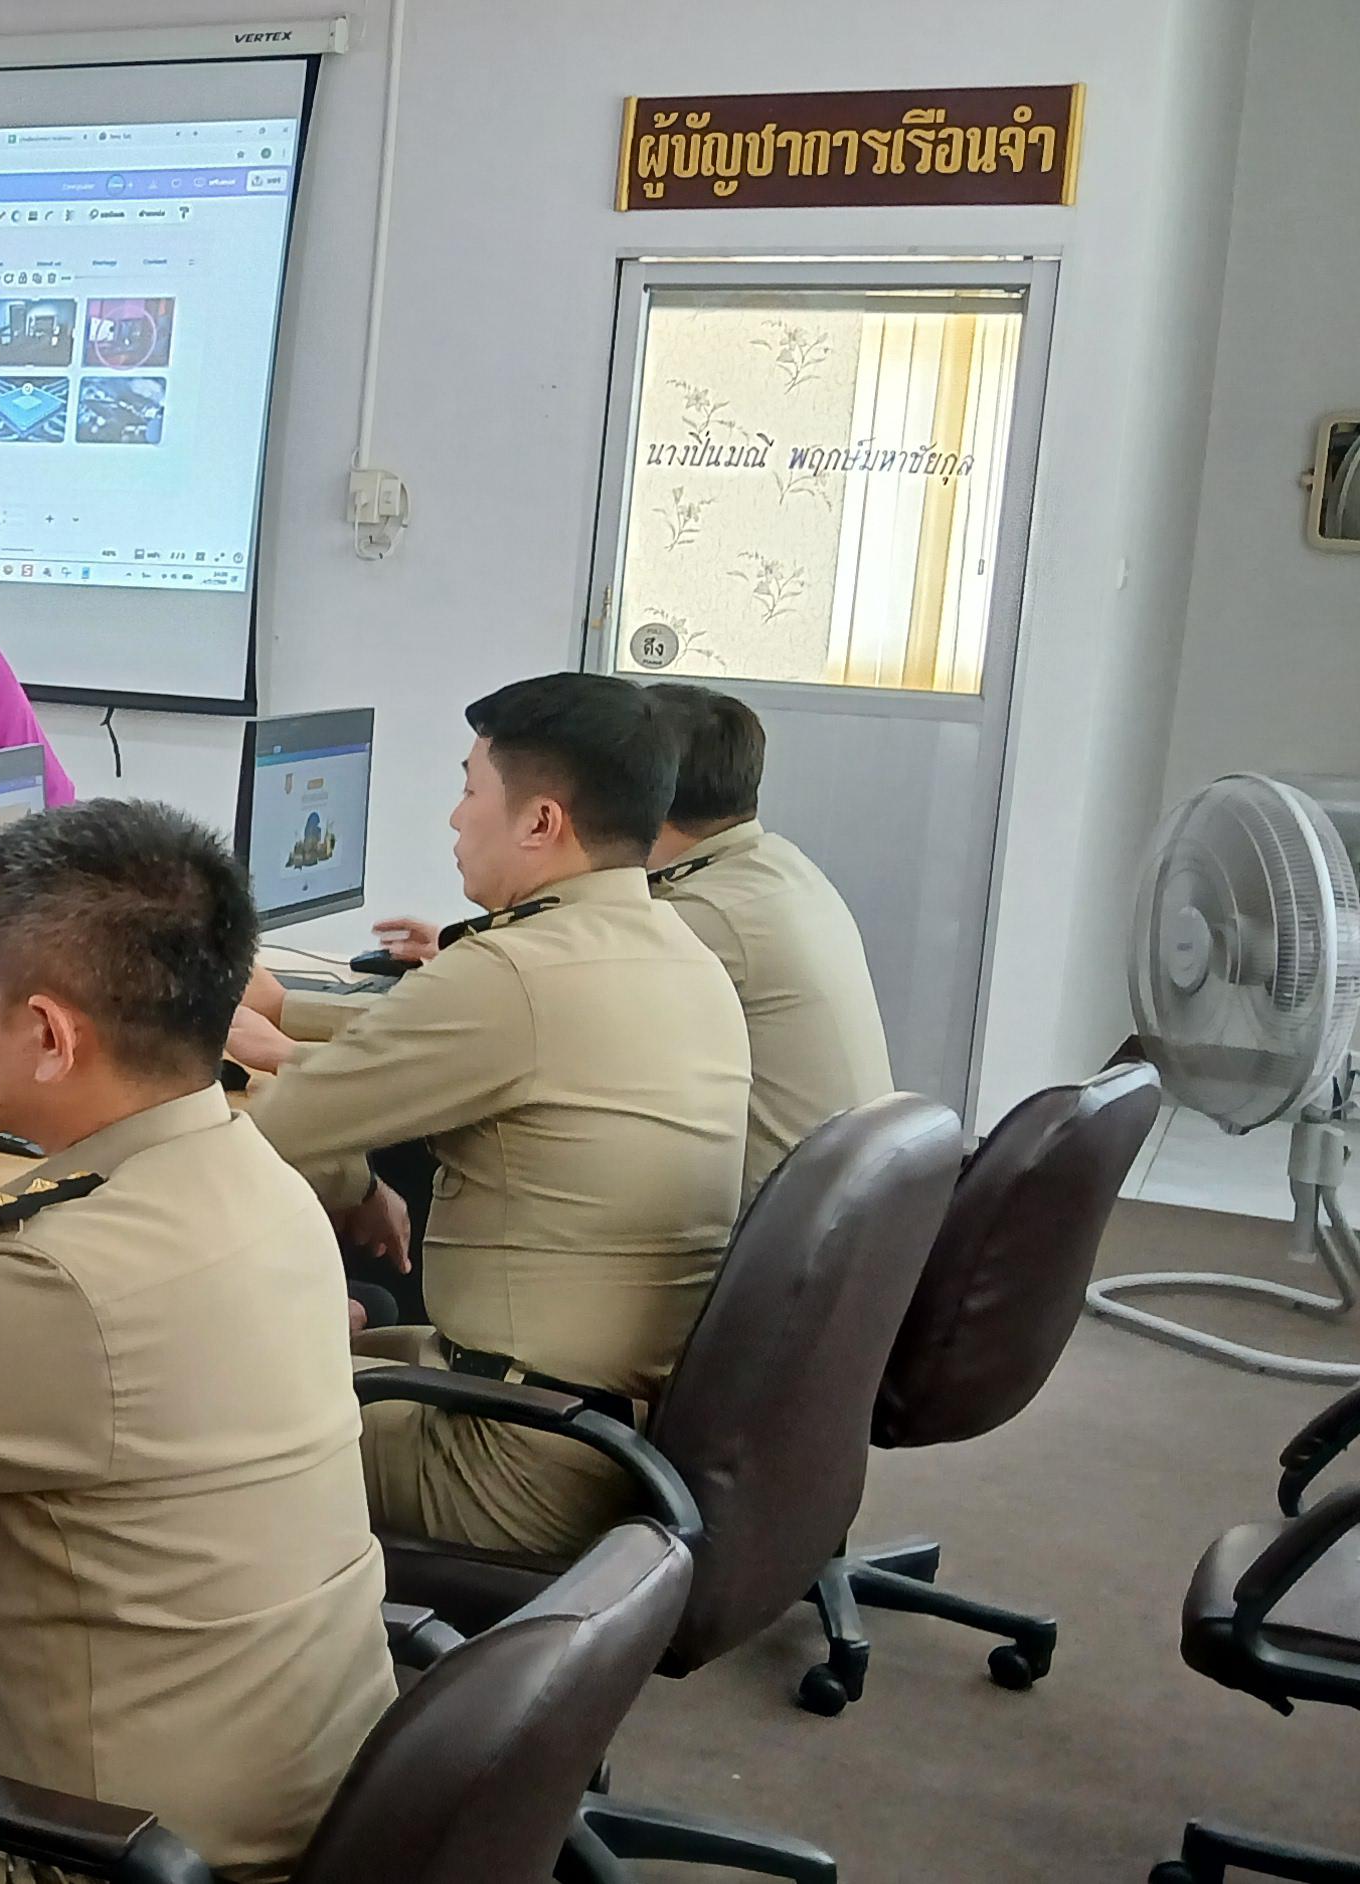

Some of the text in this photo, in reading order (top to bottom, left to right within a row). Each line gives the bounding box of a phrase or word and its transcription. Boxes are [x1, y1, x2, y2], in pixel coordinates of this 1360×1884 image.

[234, 31, 293, 44] VERTEX
[637, 106, 1056, 199] ผู้บัญชาการเรือนจำ
[646, 430, 775, 469] นางปิ่นมณี
